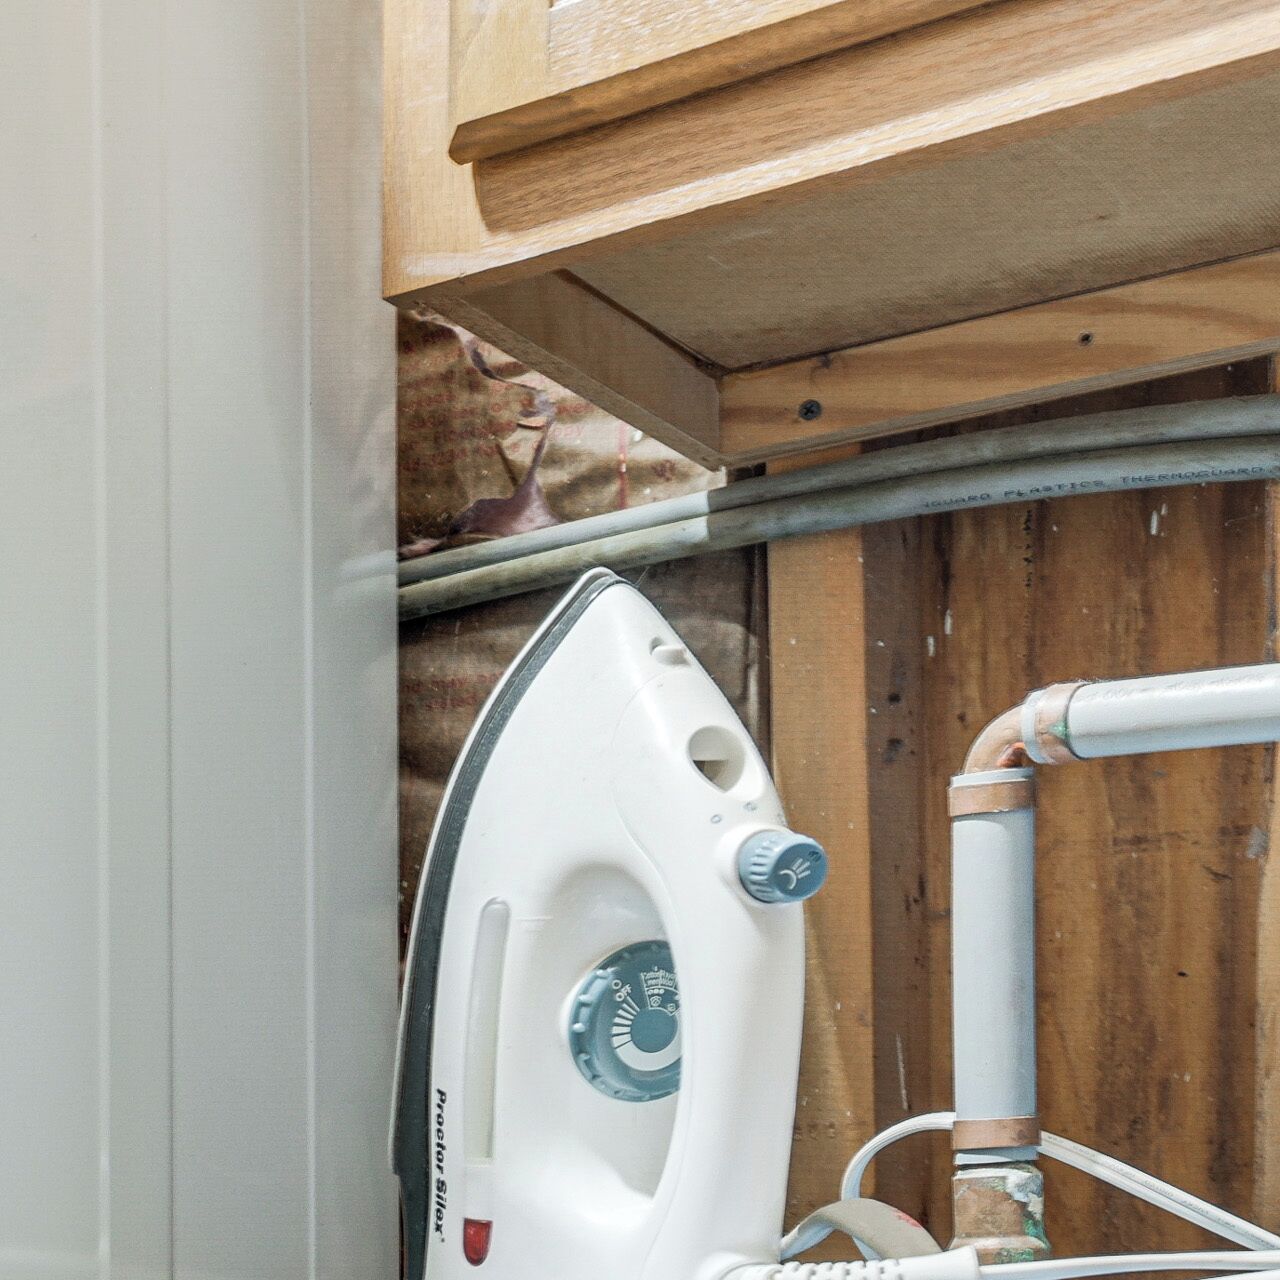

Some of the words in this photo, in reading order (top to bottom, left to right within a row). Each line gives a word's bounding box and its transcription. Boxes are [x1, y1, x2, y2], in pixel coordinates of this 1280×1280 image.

[1004, 479, 1105, 498] PLASTICS
[616, 984, 632, 1001] OFF
[436, 1088, 448, 1174] Proctor
